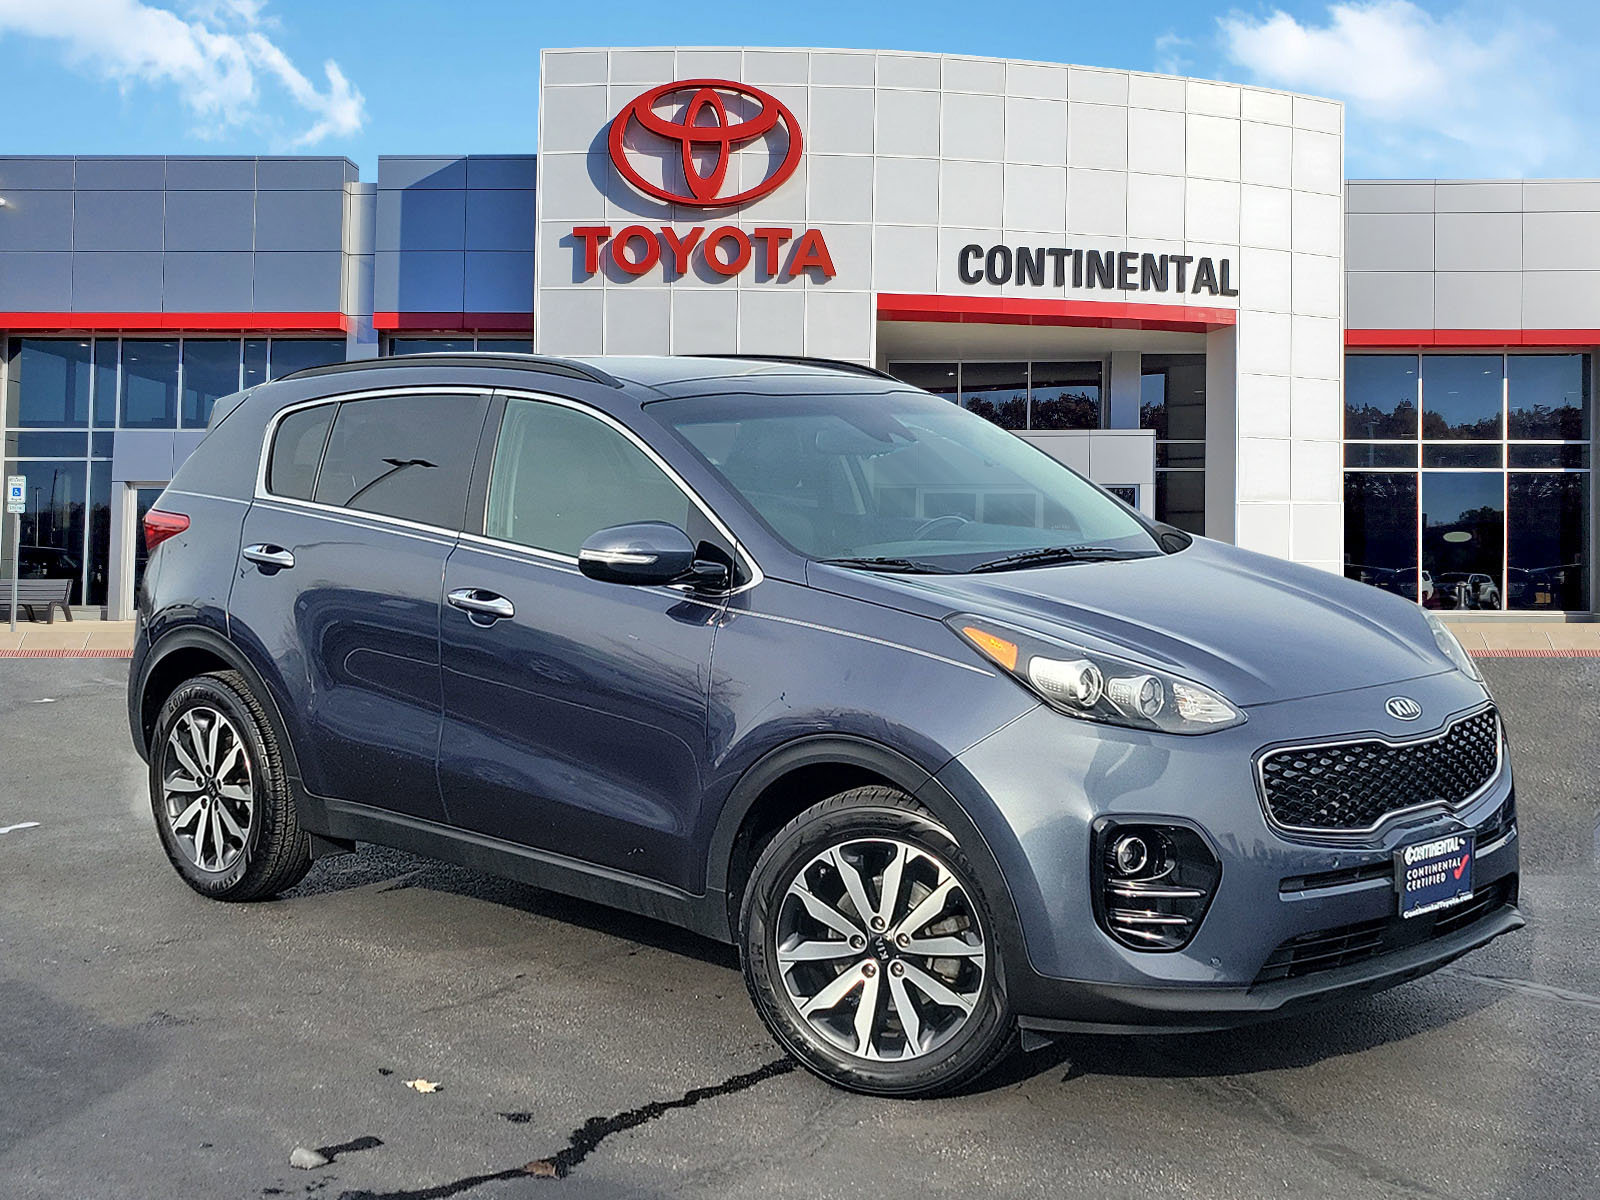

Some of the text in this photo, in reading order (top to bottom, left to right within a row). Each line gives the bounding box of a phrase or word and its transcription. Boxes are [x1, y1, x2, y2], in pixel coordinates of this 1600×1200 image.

[572, 225, 837, 276] TOYOTA
[958, 244, 1239, 297] CONTINENTAL
[1387, 699, 1420, 717] KIA
[1405, 837, 1460, 865] CONTINENTAL
[1406, 857, 1461, 880] CONTINENTAL
[1406, 873, 1446, 892] CERTIFIED
[875, 936, 889, 960] KIA
